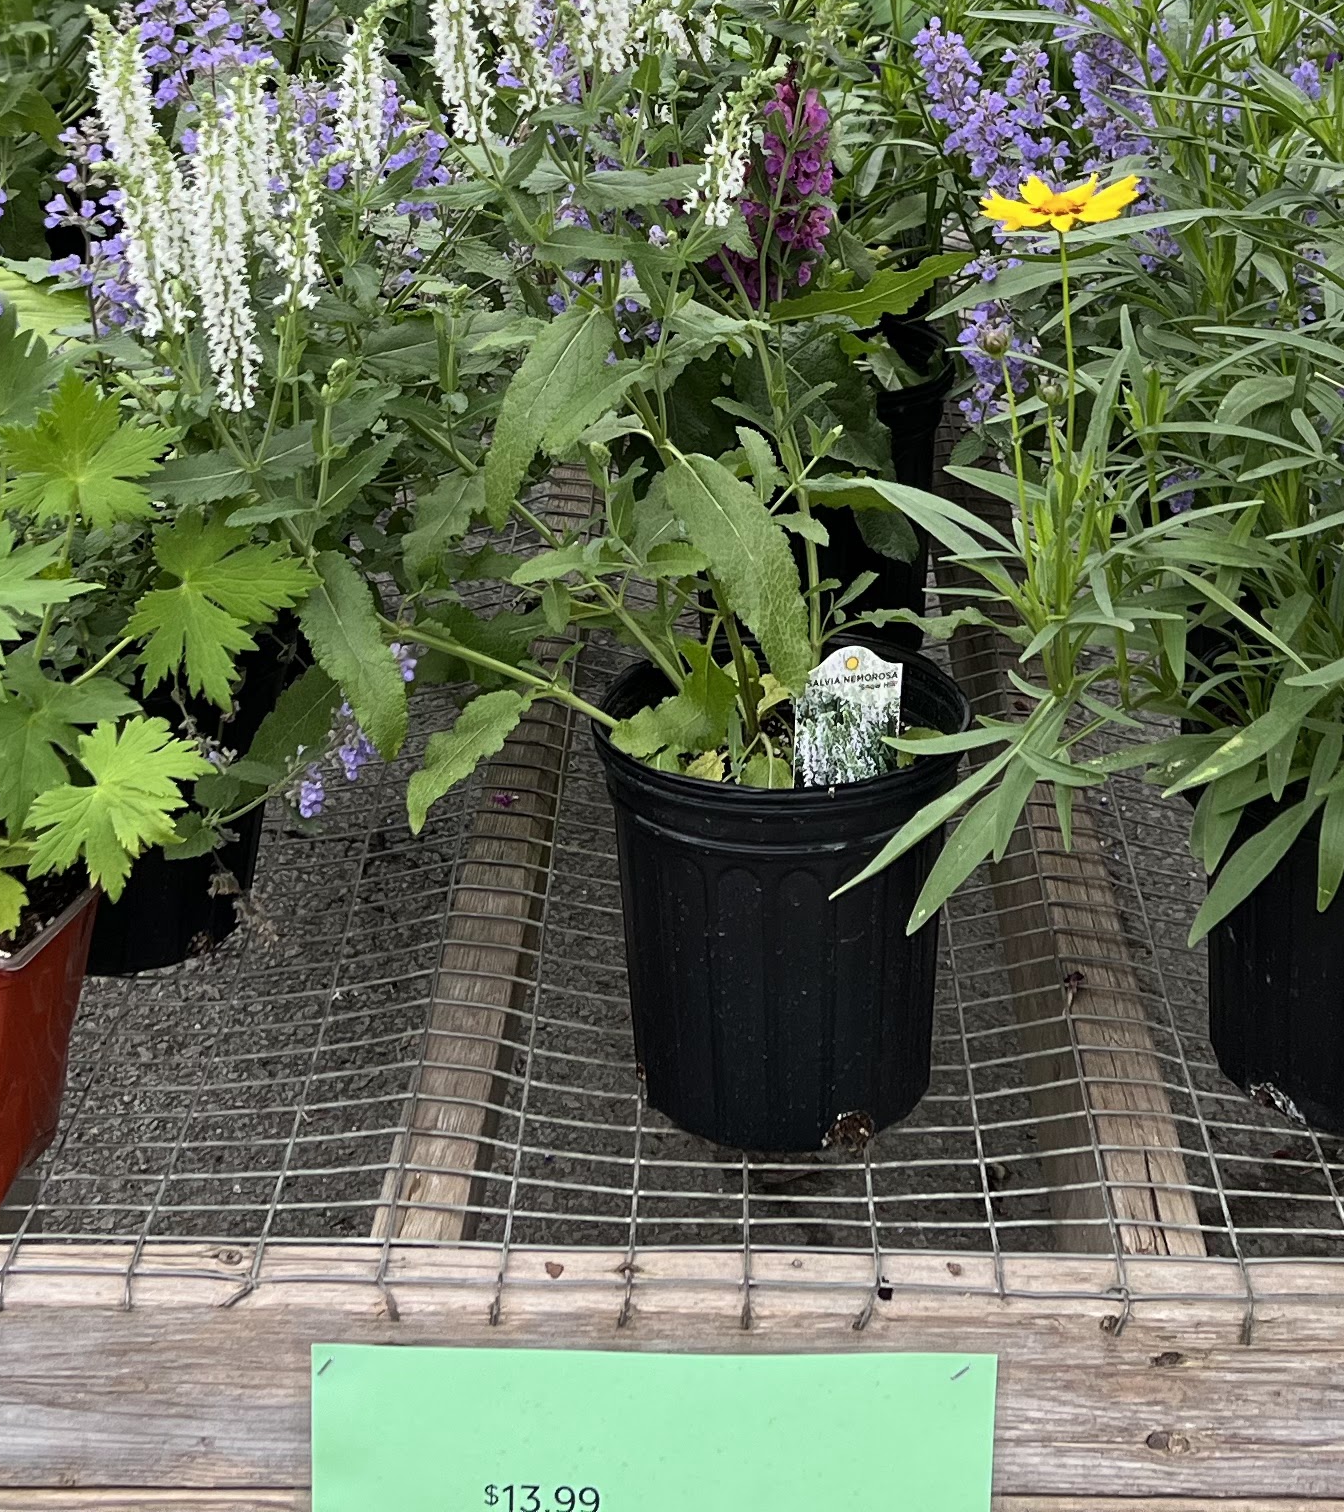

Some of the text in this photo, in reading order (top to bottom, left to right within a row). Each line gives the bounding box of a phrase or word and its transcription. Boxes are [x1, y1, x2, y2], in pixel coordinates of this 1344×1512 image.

[807, 671, 898, 688] SALVIA NEMOROSA
[484, 1483, 600, 1512] $13.99
